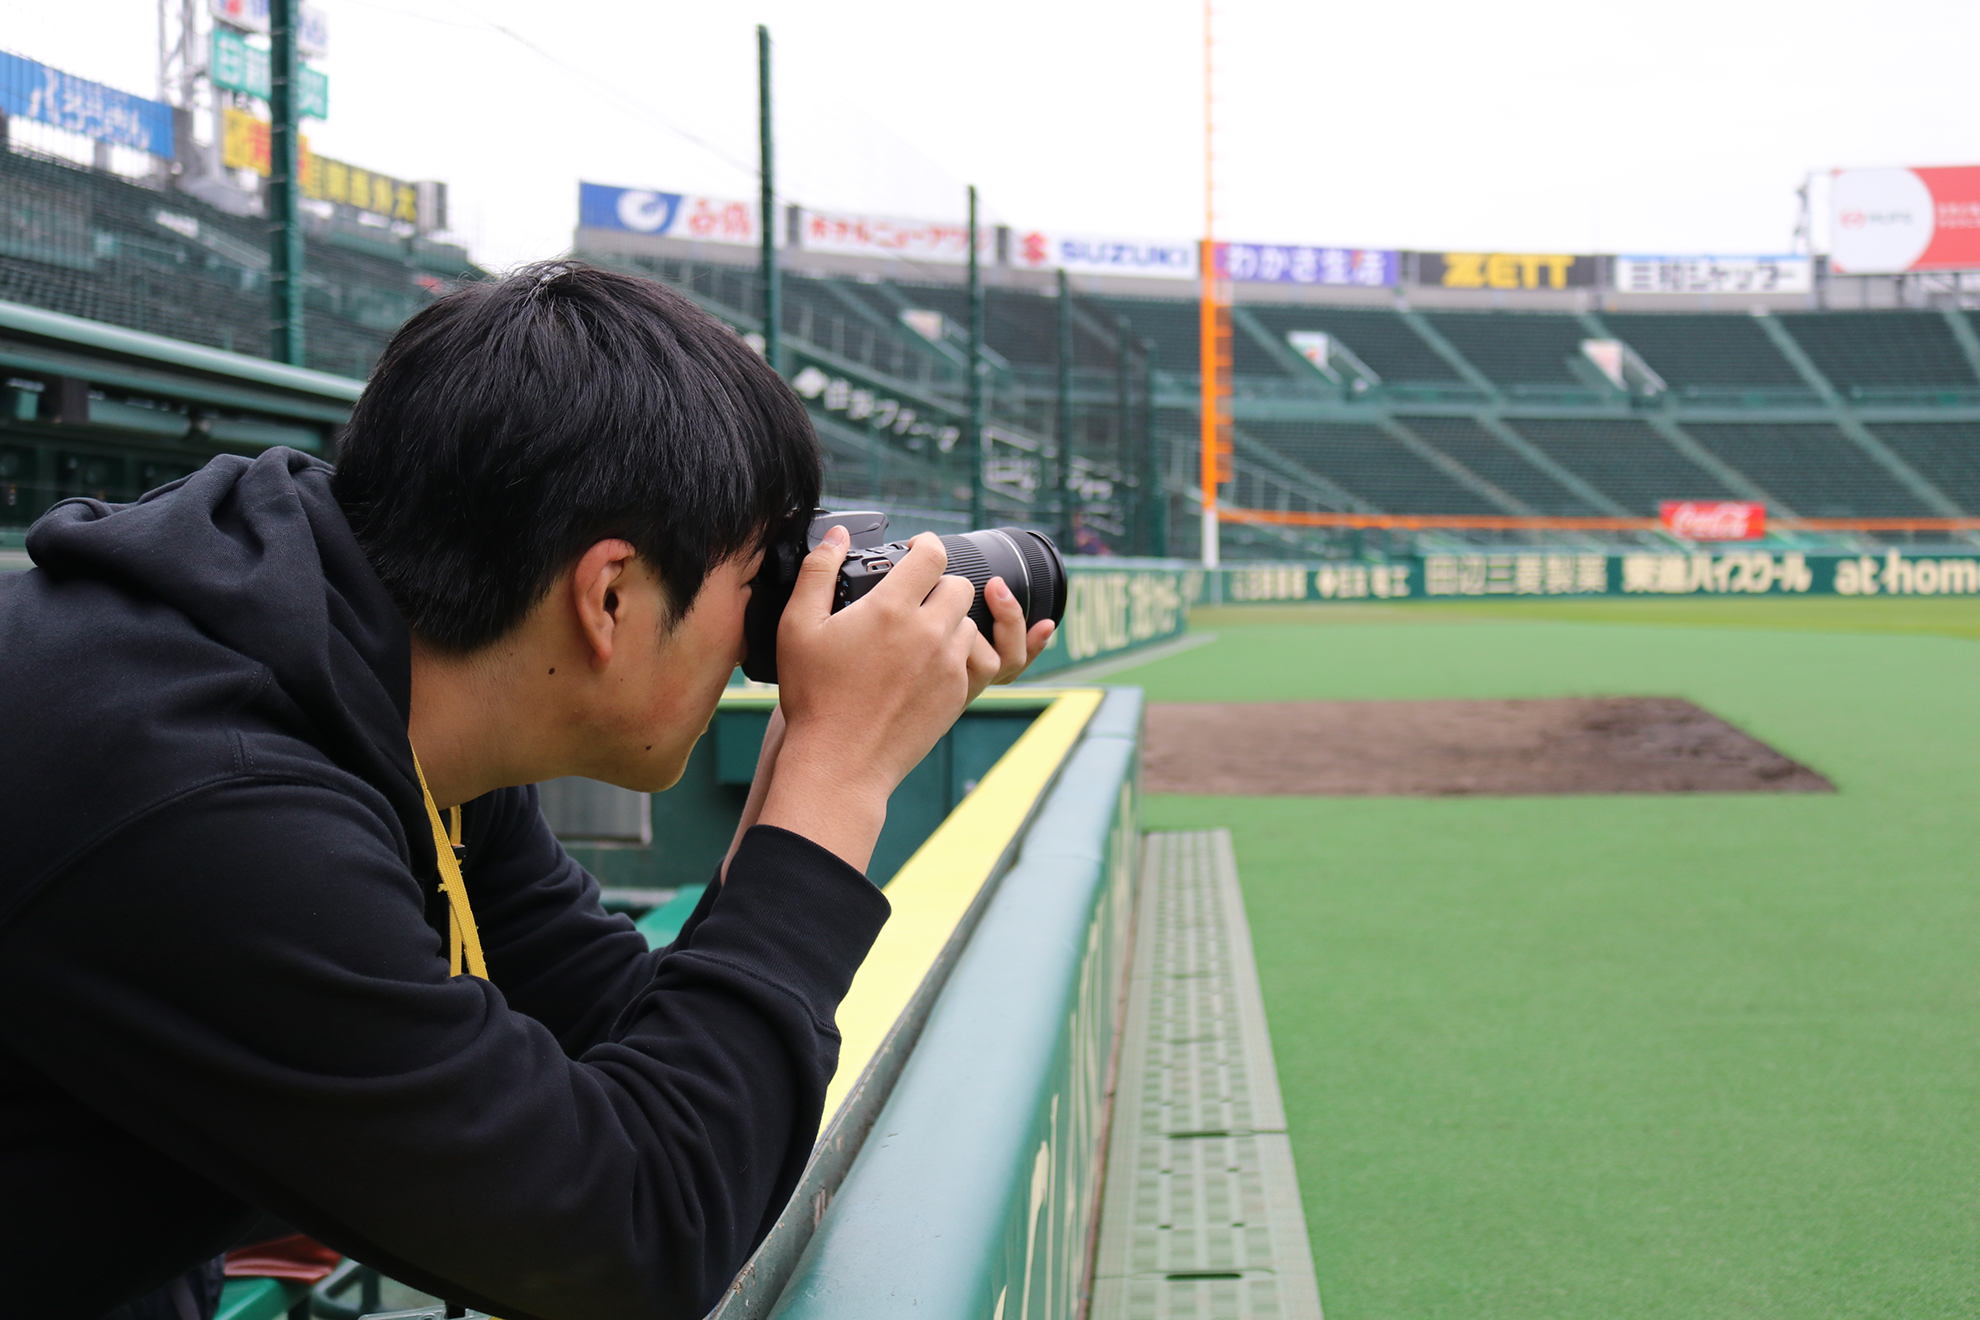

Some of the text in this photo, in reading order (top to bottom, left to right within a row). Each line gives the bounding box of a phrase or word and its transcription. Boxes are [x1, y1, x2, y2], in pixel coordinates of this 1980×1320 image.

[1059, 240, 1191, 268] SUZUKI
[1227, 246, 1388, 286] わかさ生活
[1442, 253, 1577, 290] ZETT
[1424, 554, 1608, 595] 田辺三菱製薬
[1621, 550, 1813, 593] 東進ハイスクール
[1880, 547, 1980, 595] hom
